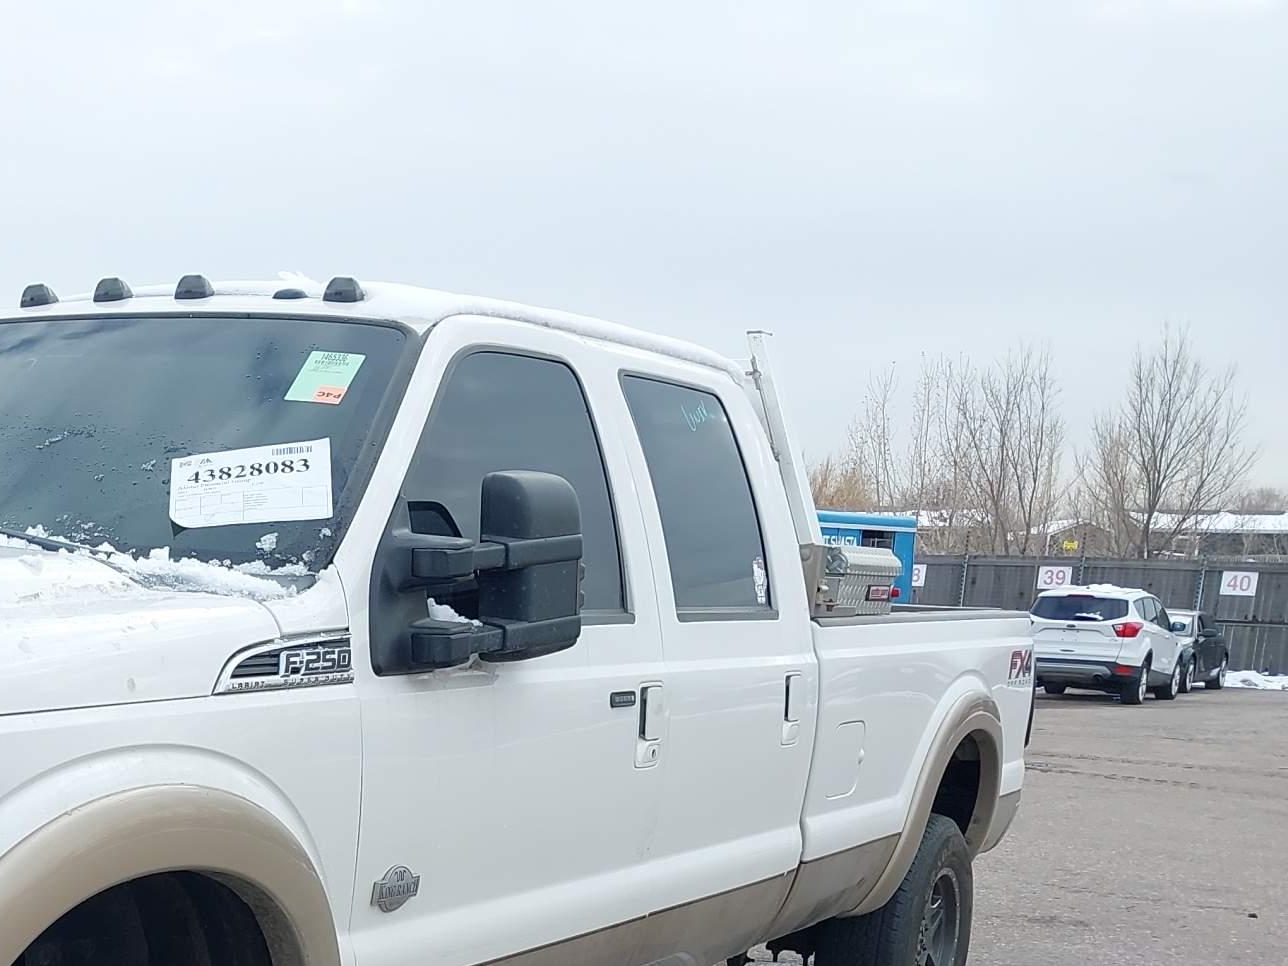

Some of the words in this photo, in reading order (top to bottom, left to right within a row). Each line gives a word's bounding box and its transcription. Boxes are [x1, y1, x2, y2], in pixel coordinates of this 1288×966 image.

[187, 458, 310, 484] 43828083
[1043, 569, 1067, 586] 39
[1226, 575, 1251, 592] 40
